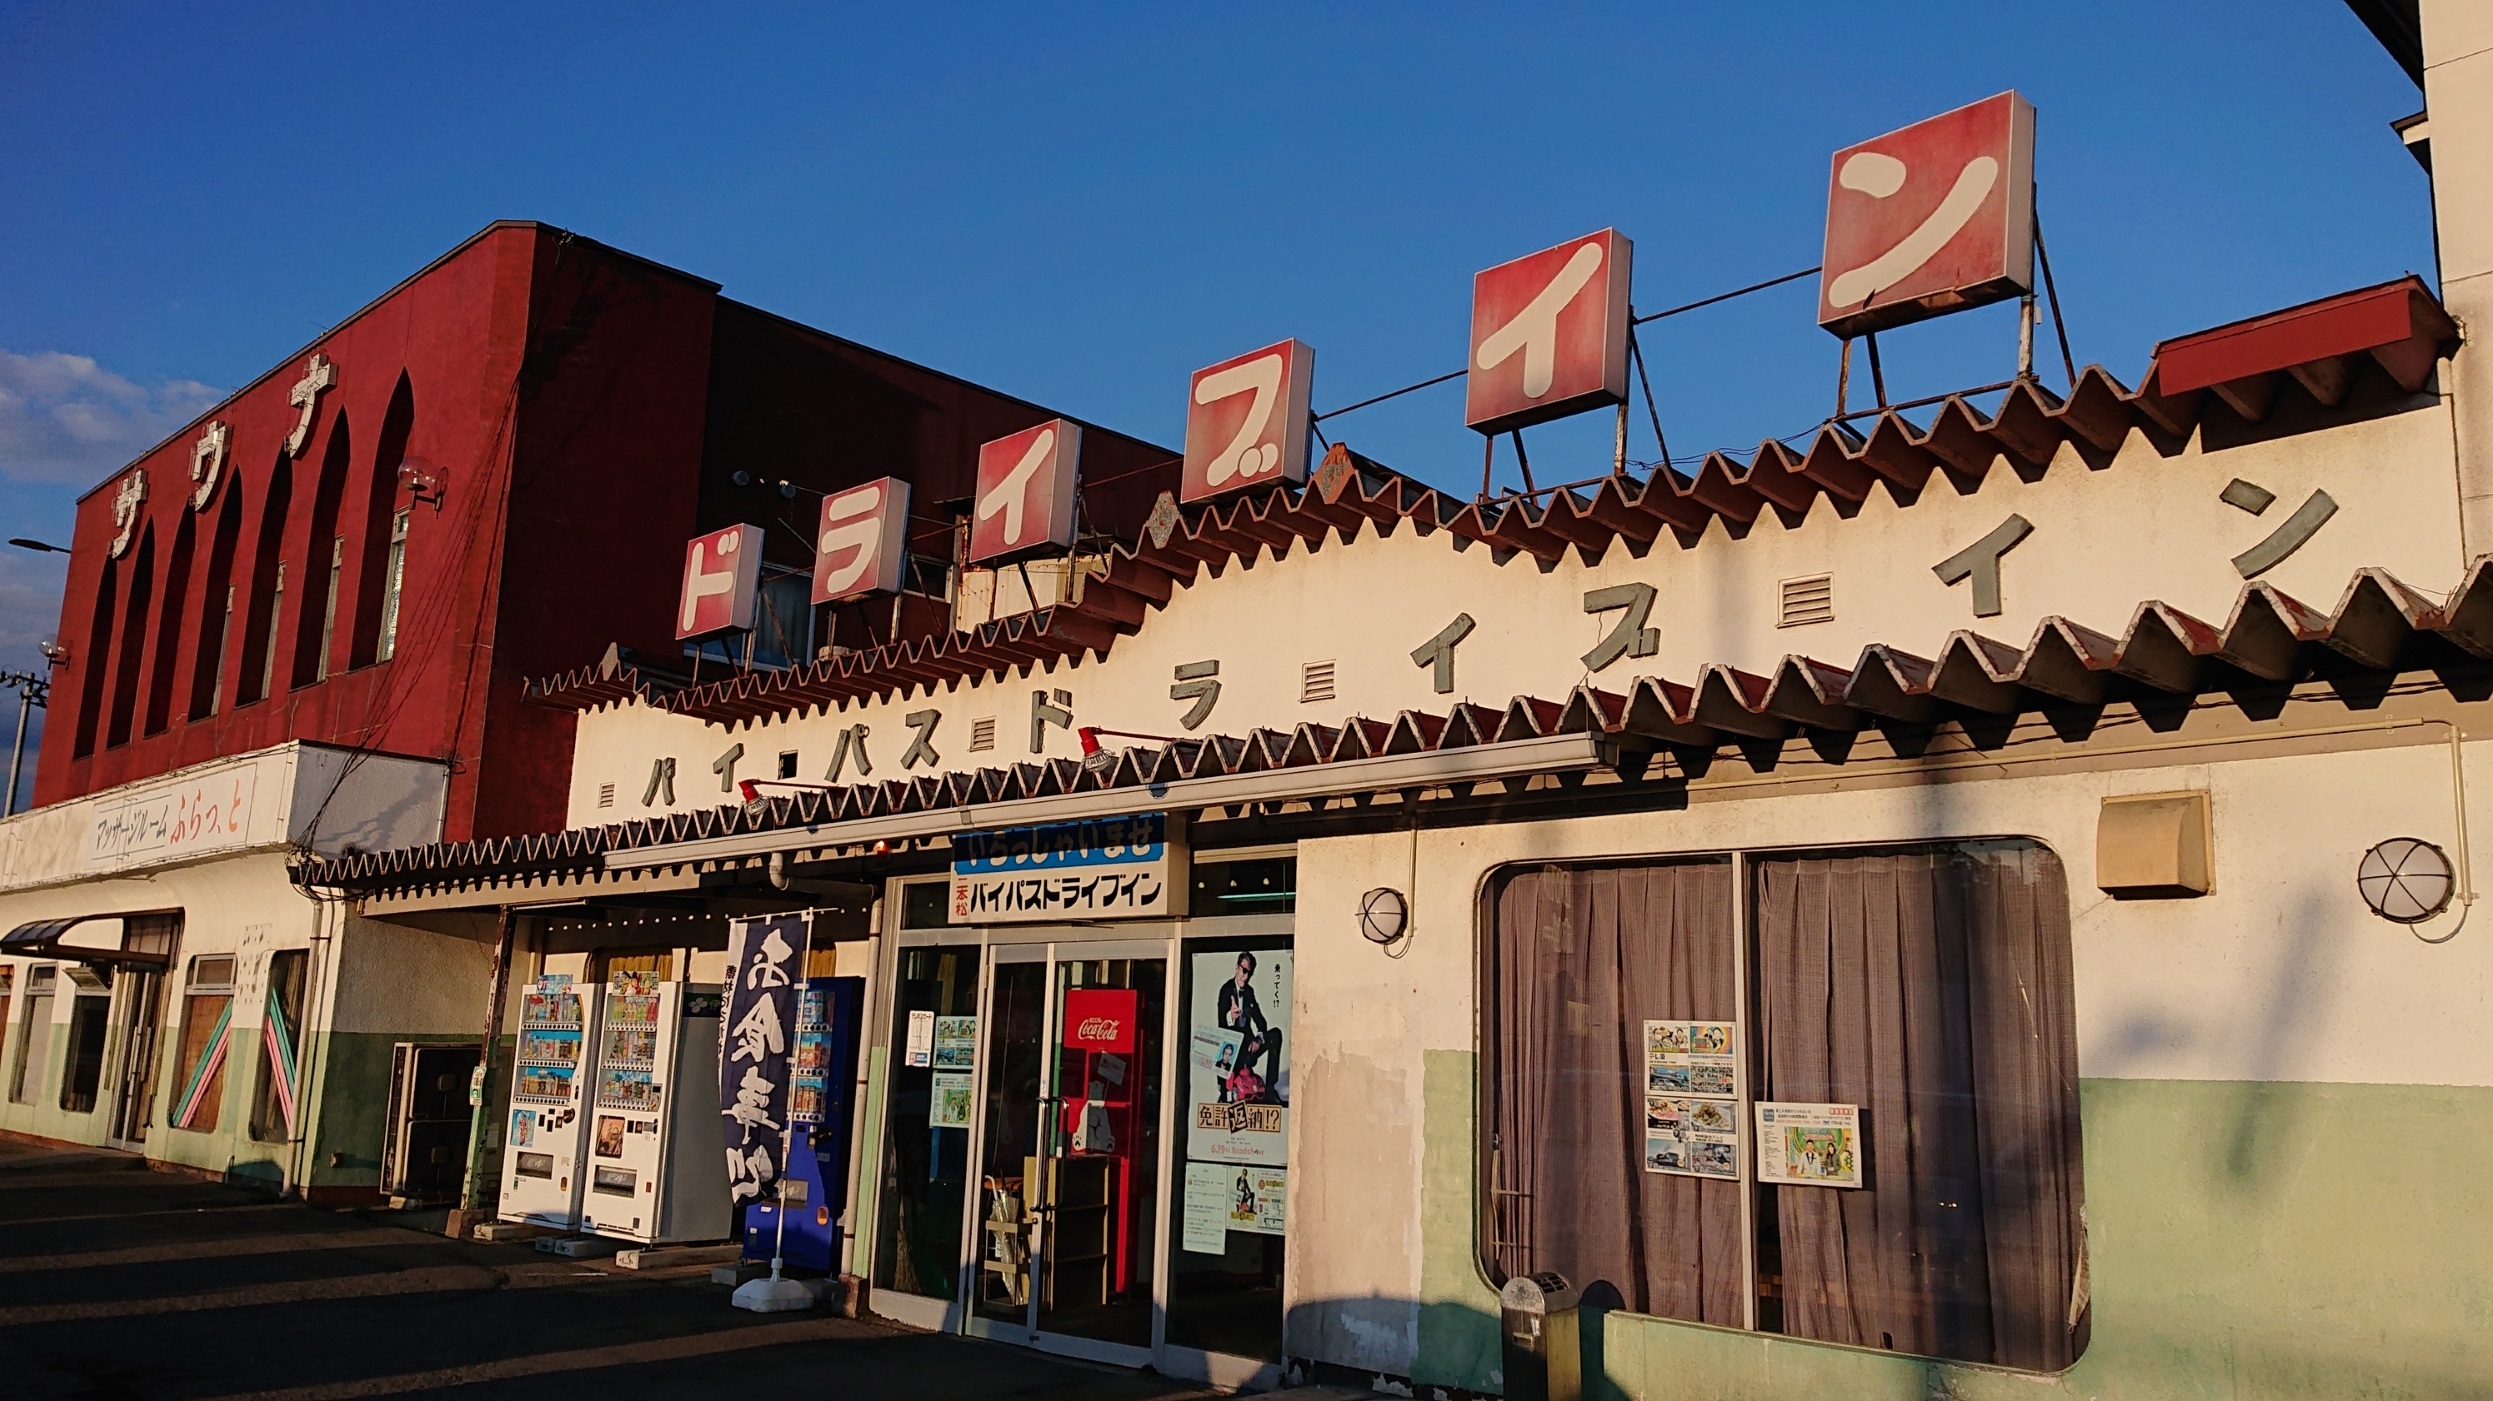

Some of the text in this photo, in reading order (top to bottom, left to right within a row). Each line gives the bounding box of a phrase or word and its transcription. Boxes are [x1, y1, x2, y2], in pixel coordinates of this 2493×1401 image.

[112, 353, 338, 559] サウナ
[968, 818, 1153, 867] いらっしゃいませ
[955, 873, 1162, 917] 二本松 バイパスドライブイン
[1199, 1103, 1279, 1131] 免許返納!?
